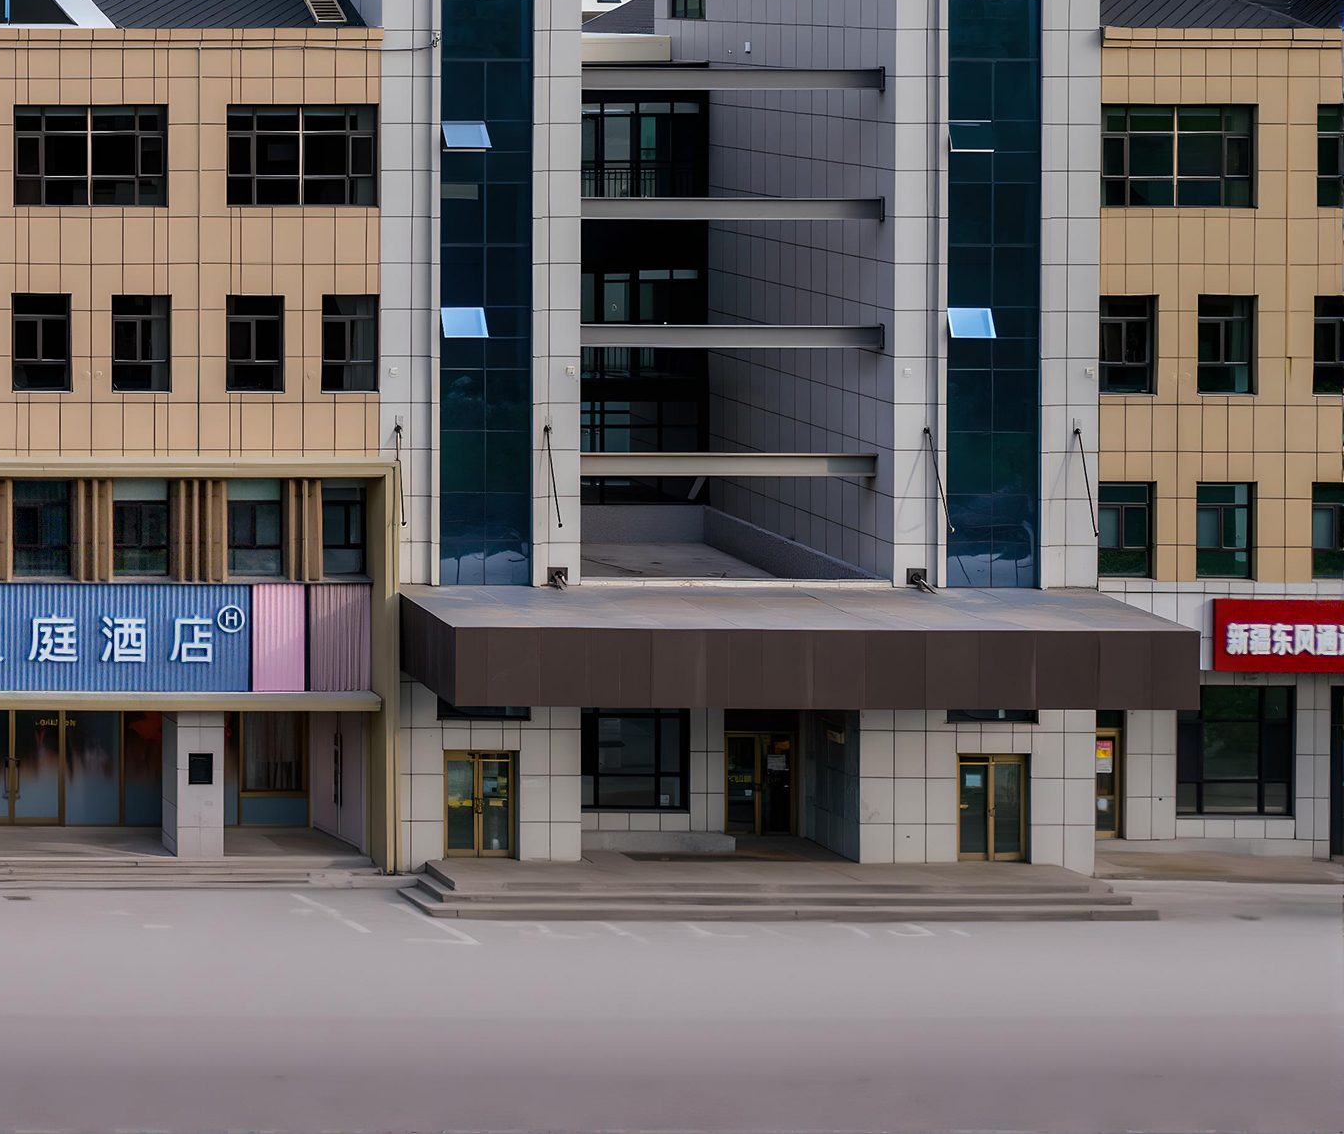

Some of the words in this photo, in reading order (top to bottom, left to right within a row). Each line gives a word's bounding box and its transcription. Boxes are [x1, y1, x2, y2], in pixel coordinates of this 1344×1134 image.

[1226, 623, 1344, 656] 新疆东风通
